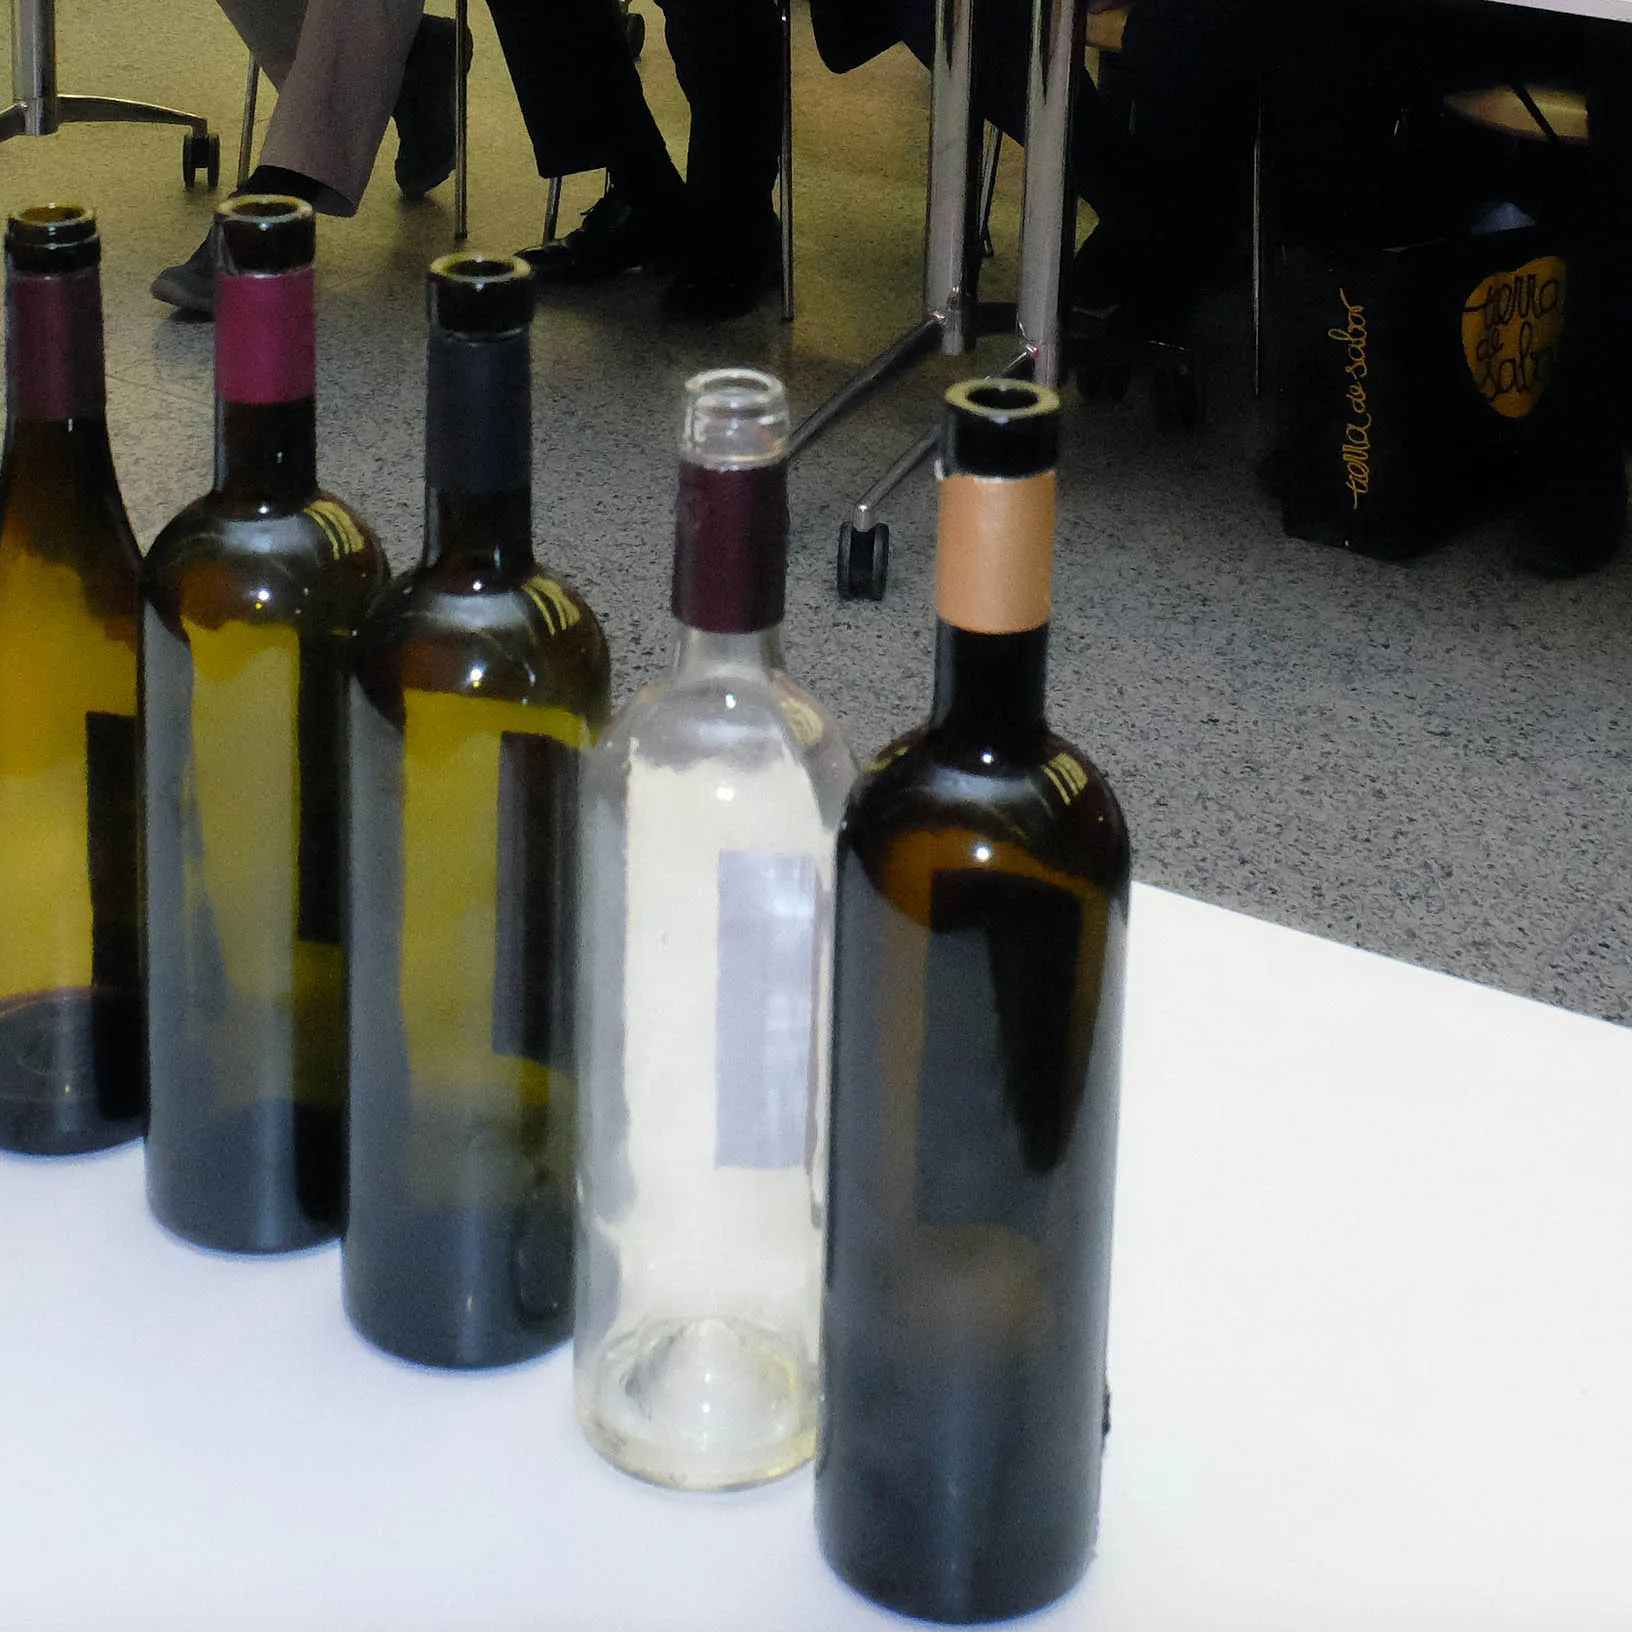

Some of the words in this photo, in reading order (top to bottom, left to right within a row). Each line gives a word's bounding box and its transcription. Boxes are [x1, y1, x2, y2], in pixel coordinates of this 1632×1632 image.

[1464, 274, 1564, 330] terra
[1328, 287, 1368, 380] sabor
[1476, 326, 1504, 362] de
[1479, 321, 1552, 402] sabo
[1346, 382, 1367, 414] de
